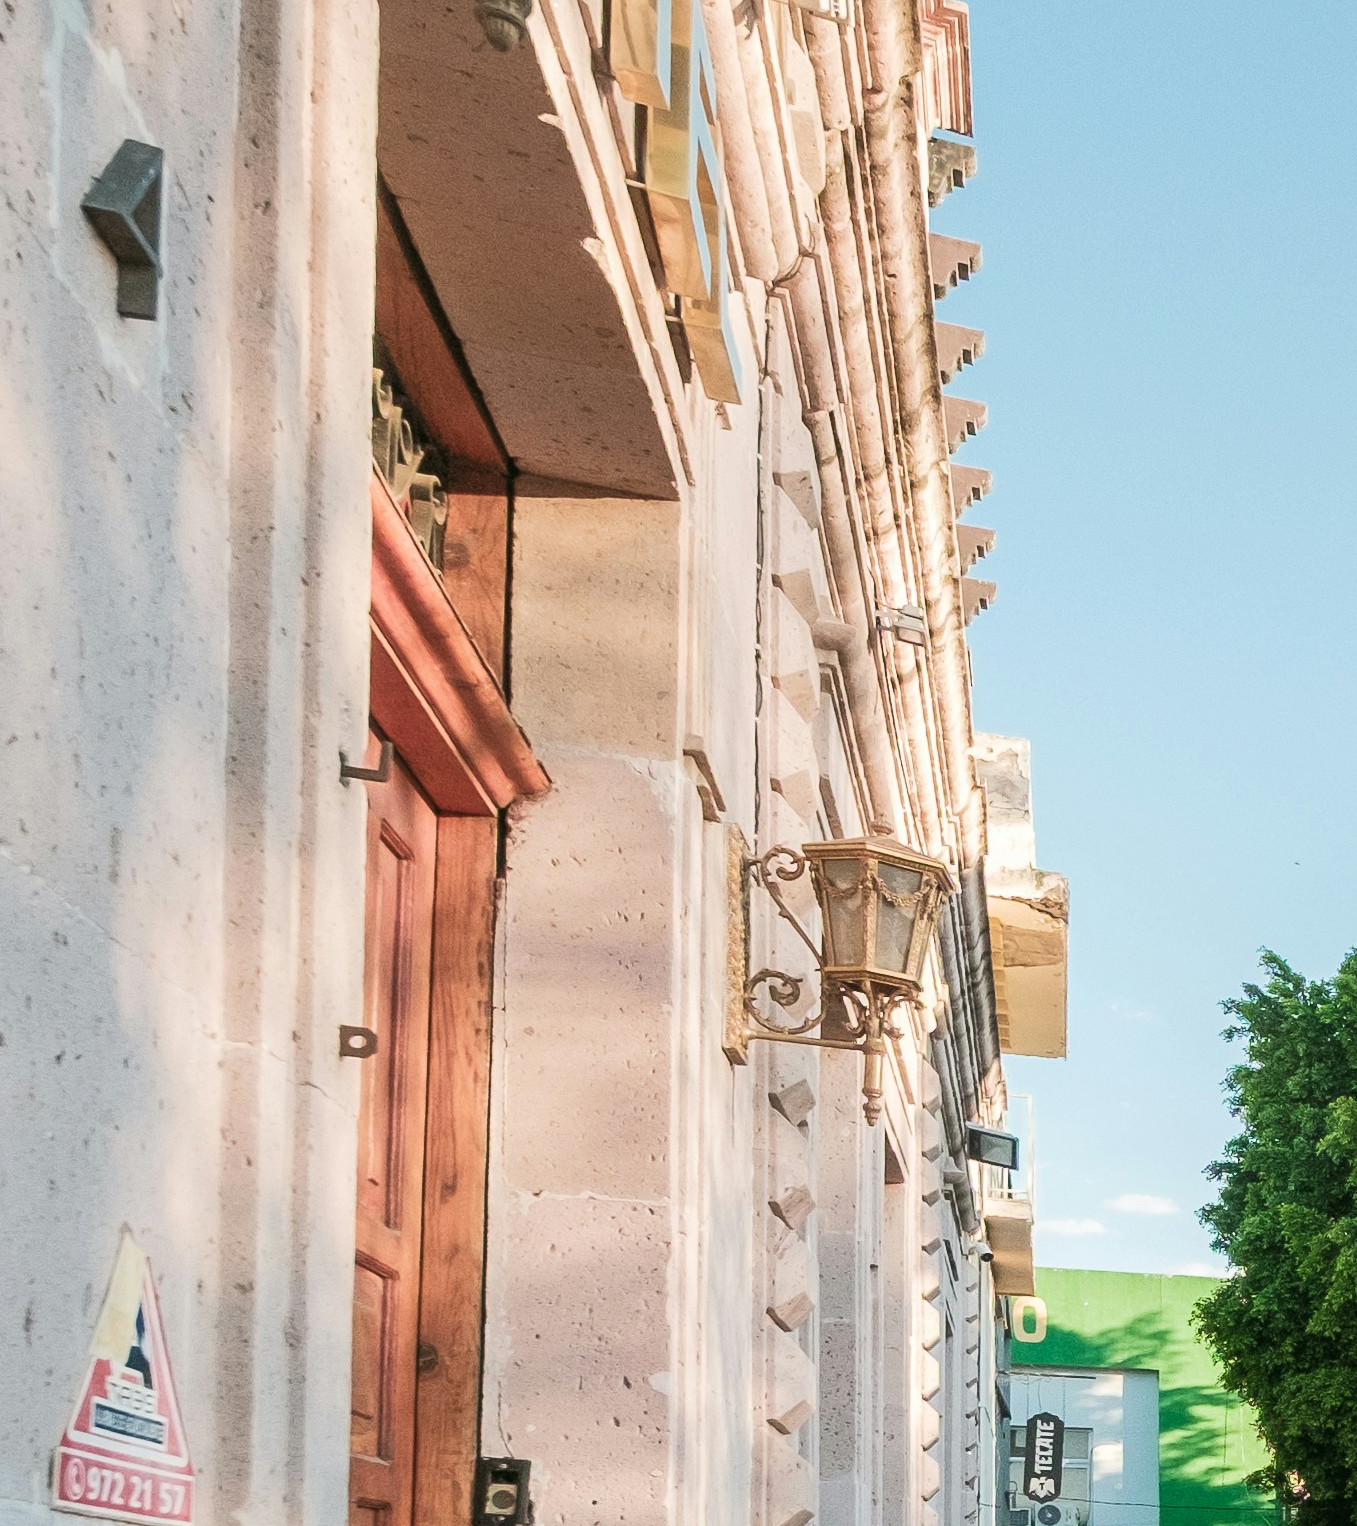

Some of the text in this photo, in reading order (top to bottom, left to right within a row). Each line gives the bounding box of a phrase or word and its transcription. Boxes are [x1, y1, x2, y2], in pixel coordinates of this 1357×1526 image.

[1033, 1419, 1055, 1474] TECATE
[86, 1465, 185, 1515] 972 21 57
